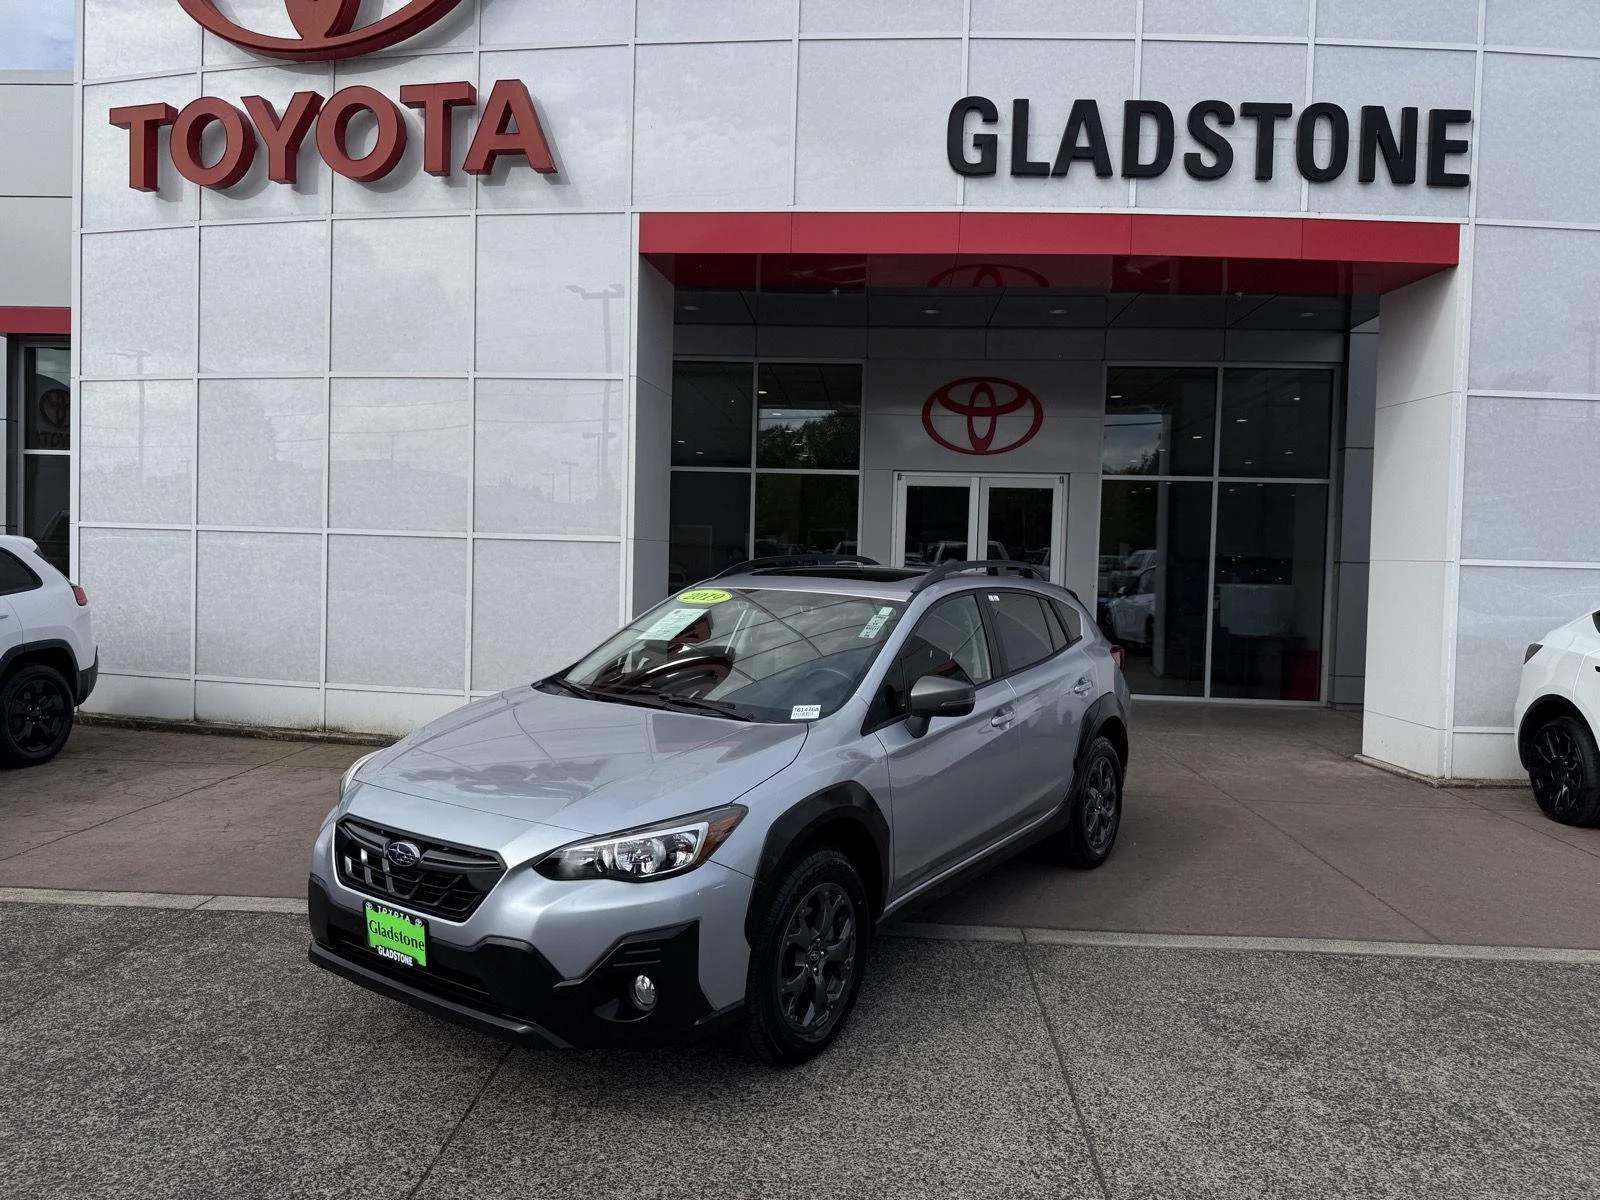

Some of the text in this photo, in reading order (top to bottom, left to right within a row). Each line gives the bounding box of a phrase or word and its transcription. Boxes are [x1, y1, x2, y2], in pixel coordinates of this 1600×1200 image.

[109, 79, 558, 192] TOYOTA
[947, 96, 1473, 187] GLADSTONE
[683, 592, 726, 601] 2019
[377, 905, 411, 922] TOYOTA
[368, 919, 425, 952] Gladstone
[378, 945, 413, 967] GLADSTONE
